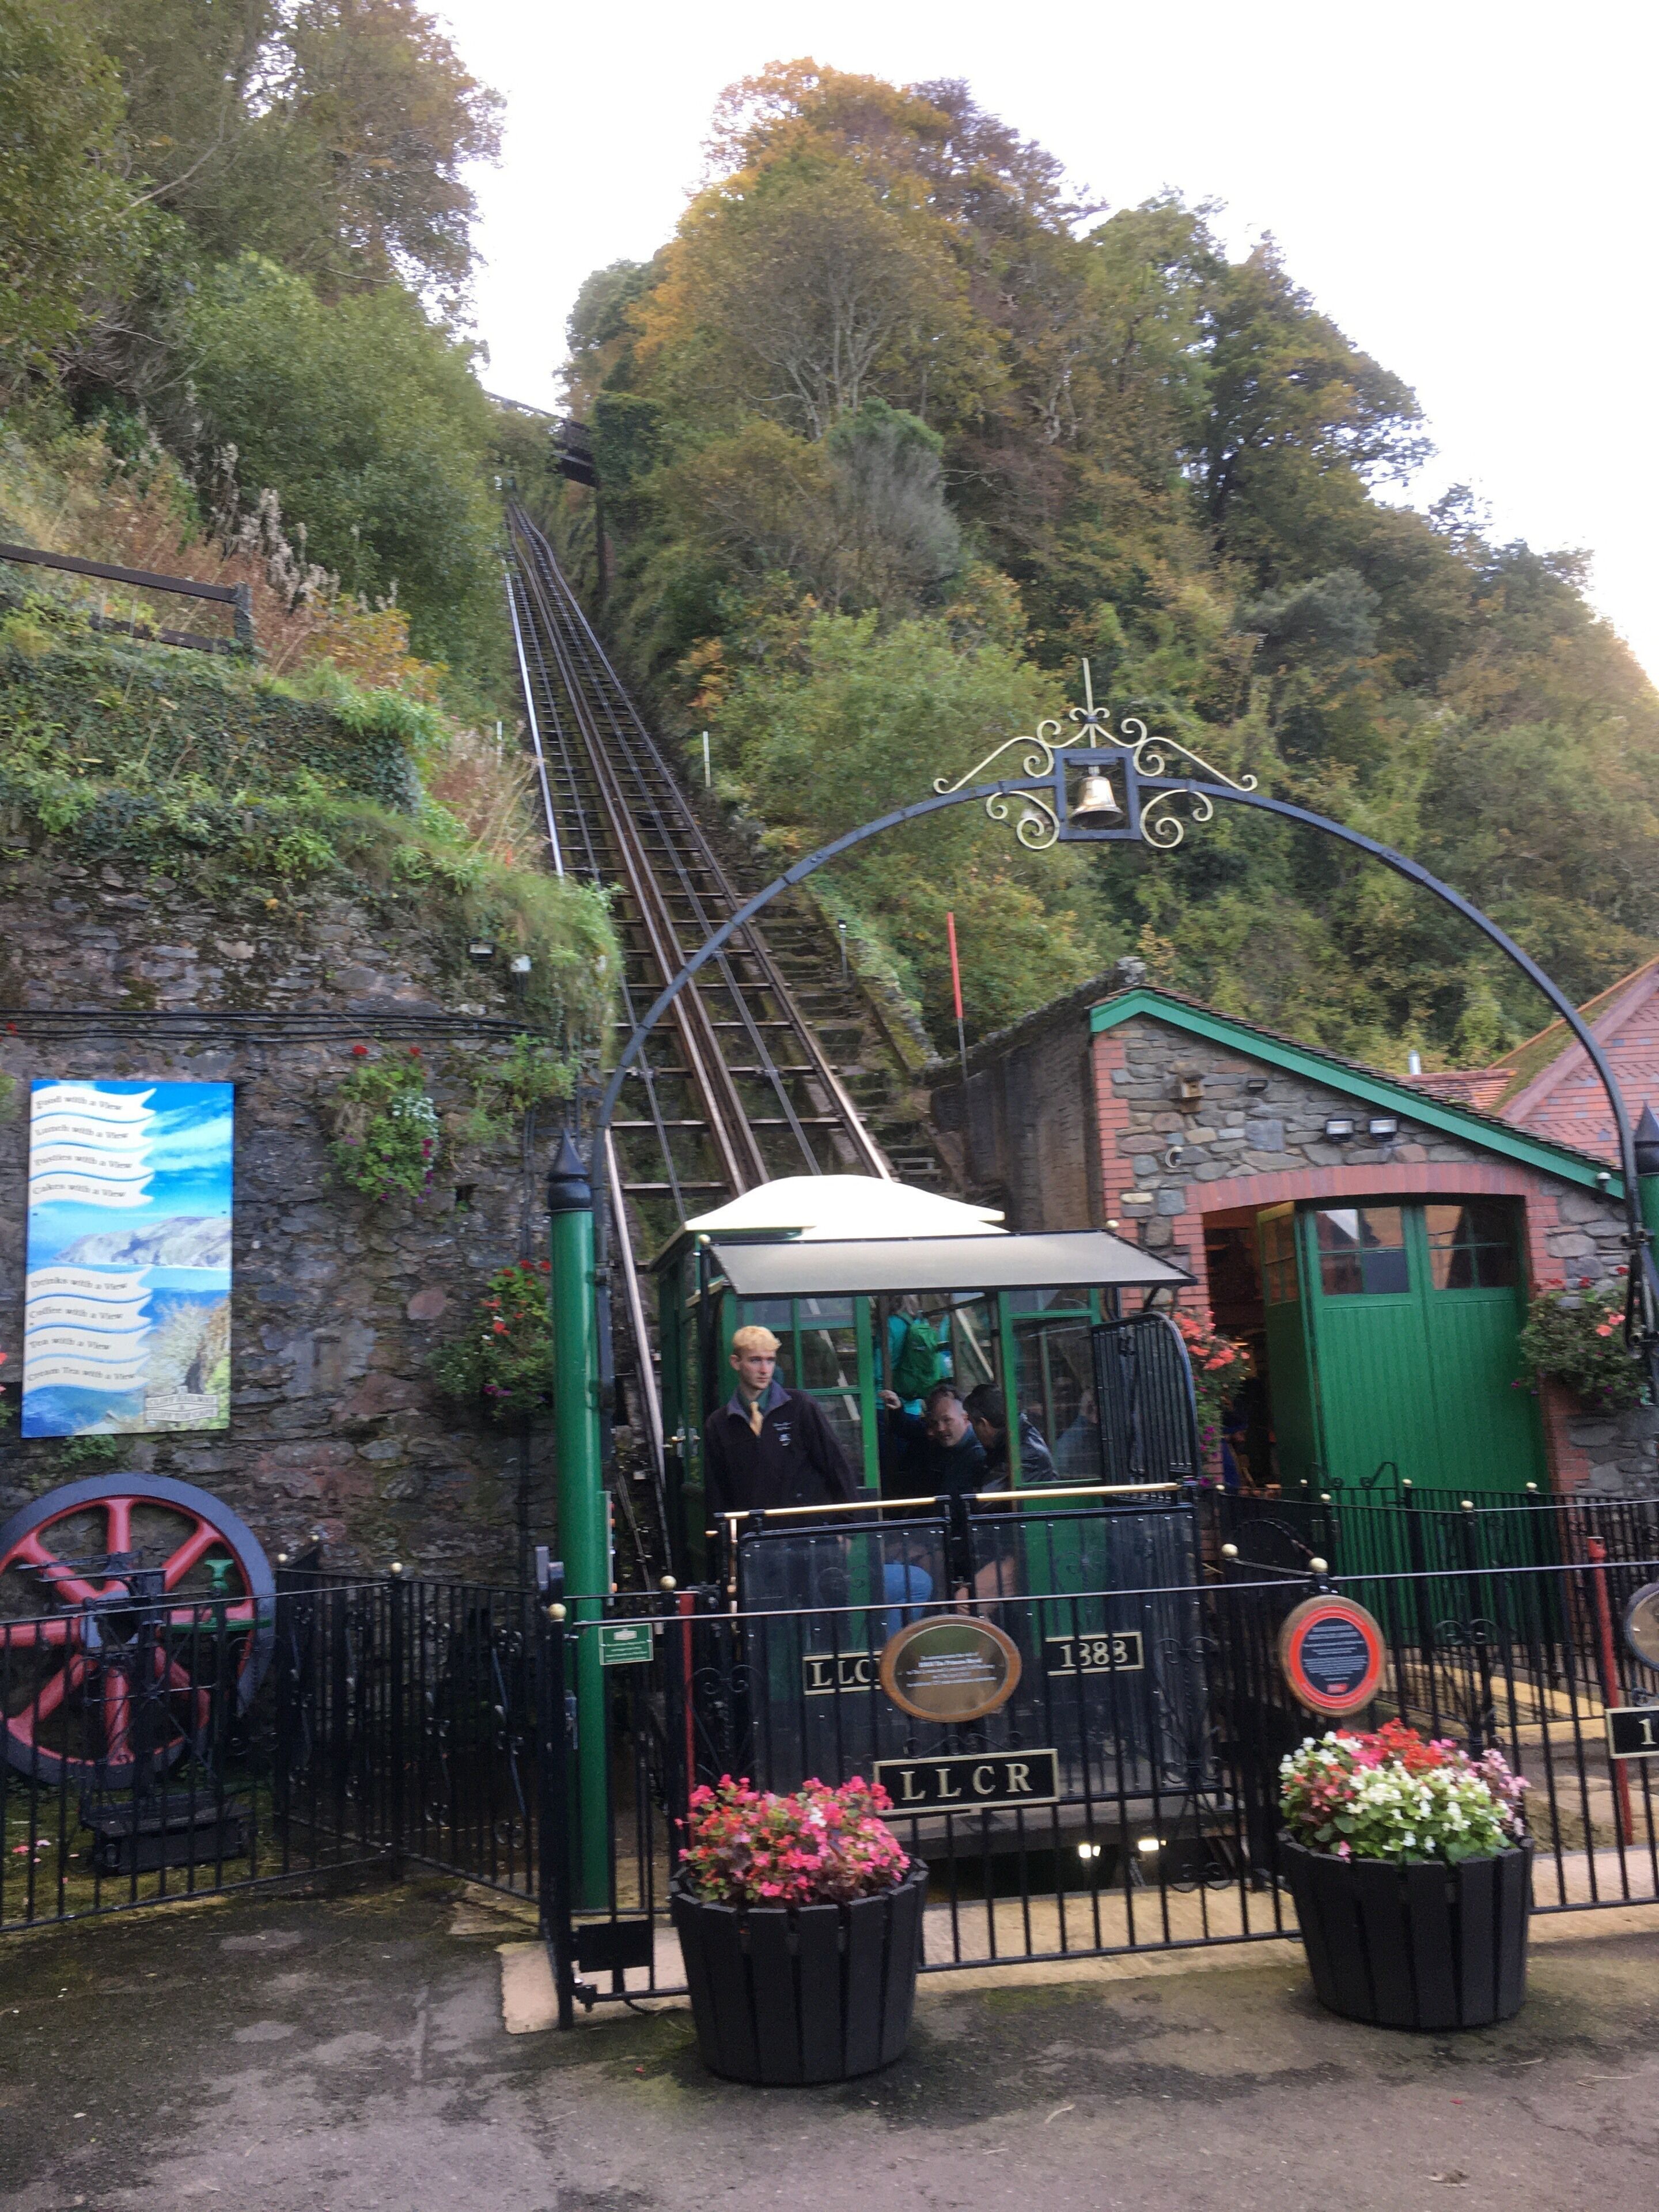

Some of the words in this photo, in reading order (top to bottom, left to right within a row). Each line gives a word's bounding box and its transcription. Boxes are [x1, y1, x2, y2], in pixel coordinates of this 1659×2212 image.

[36, 1096, 62, 1109] Food
[64, 1096, 88, 1104] with
[99, 1101, 123, 1110] View
[35, 1124, 69, 1136] Lunch
[72, 1127, 94, 1136] with
[74, 1156, 97, 1164] with
[108, 1160, 133, 1168] View
[32, 1183, 66, 1195] Cakes
[68, 1184, 91, 1193] with
[101, 1188, 127, 1197] View
[70, 1280, 93, 1288] with
[29, 1306, 62, 1319] Coffee
[66, 1309, 88, 1317] with
[29, 1339, 49, 1349] Tea
[51, 1338, 75, 1346] with
[88, 1340, 111, 1350] View
[27, 1368, 60, 1381] Cream
[62, 1366, 79, 1374] Tea
[82, 1370, 103, 1378] with
[810, 1658, 881, 1687] LLC
